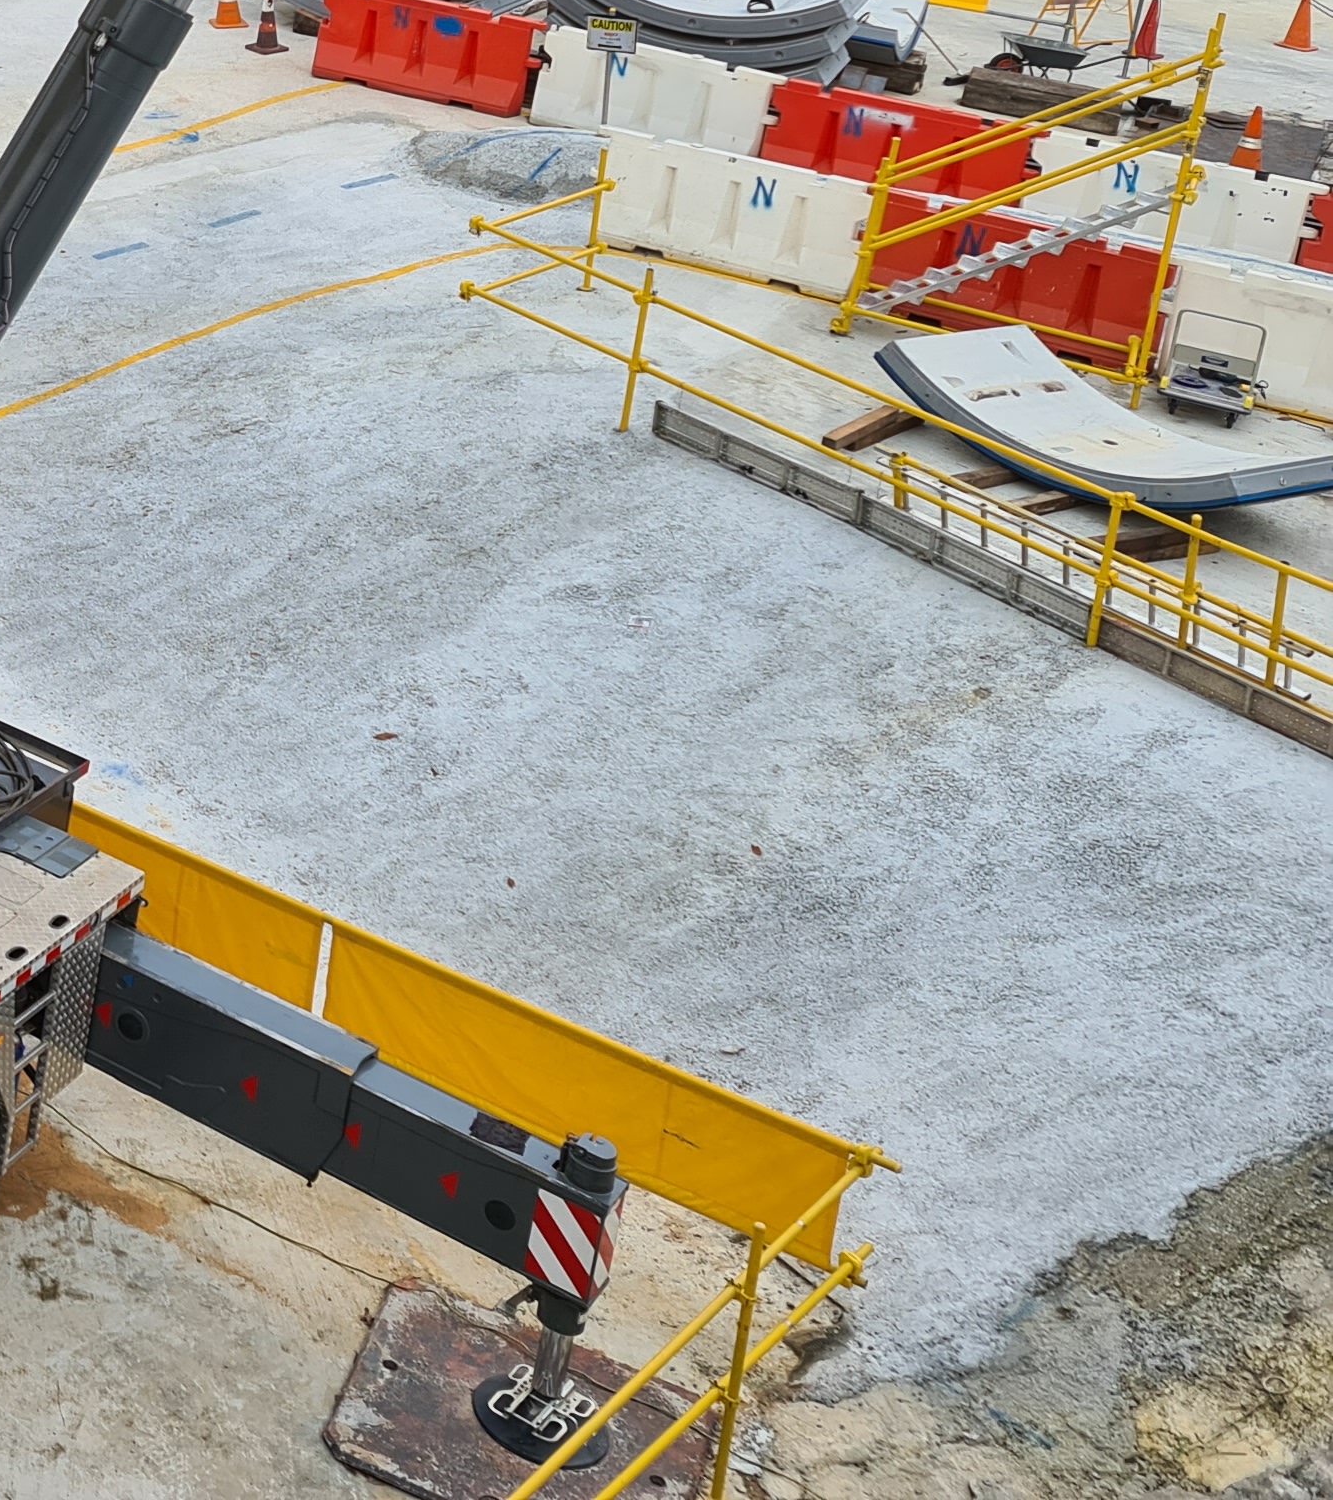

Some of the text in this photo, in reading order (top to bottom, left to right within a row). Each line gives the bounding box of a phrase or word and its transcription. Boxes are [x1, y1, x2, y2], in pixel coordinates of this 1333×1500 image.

[393, 5, 411, 29] N
[591, 18, 633, 32] CAUTION
[843, 105, 865, 137] N
[750, 175, 777, 209] N
[1113, 161, 1140, 195] N
[956, 223, 987, 256] N
